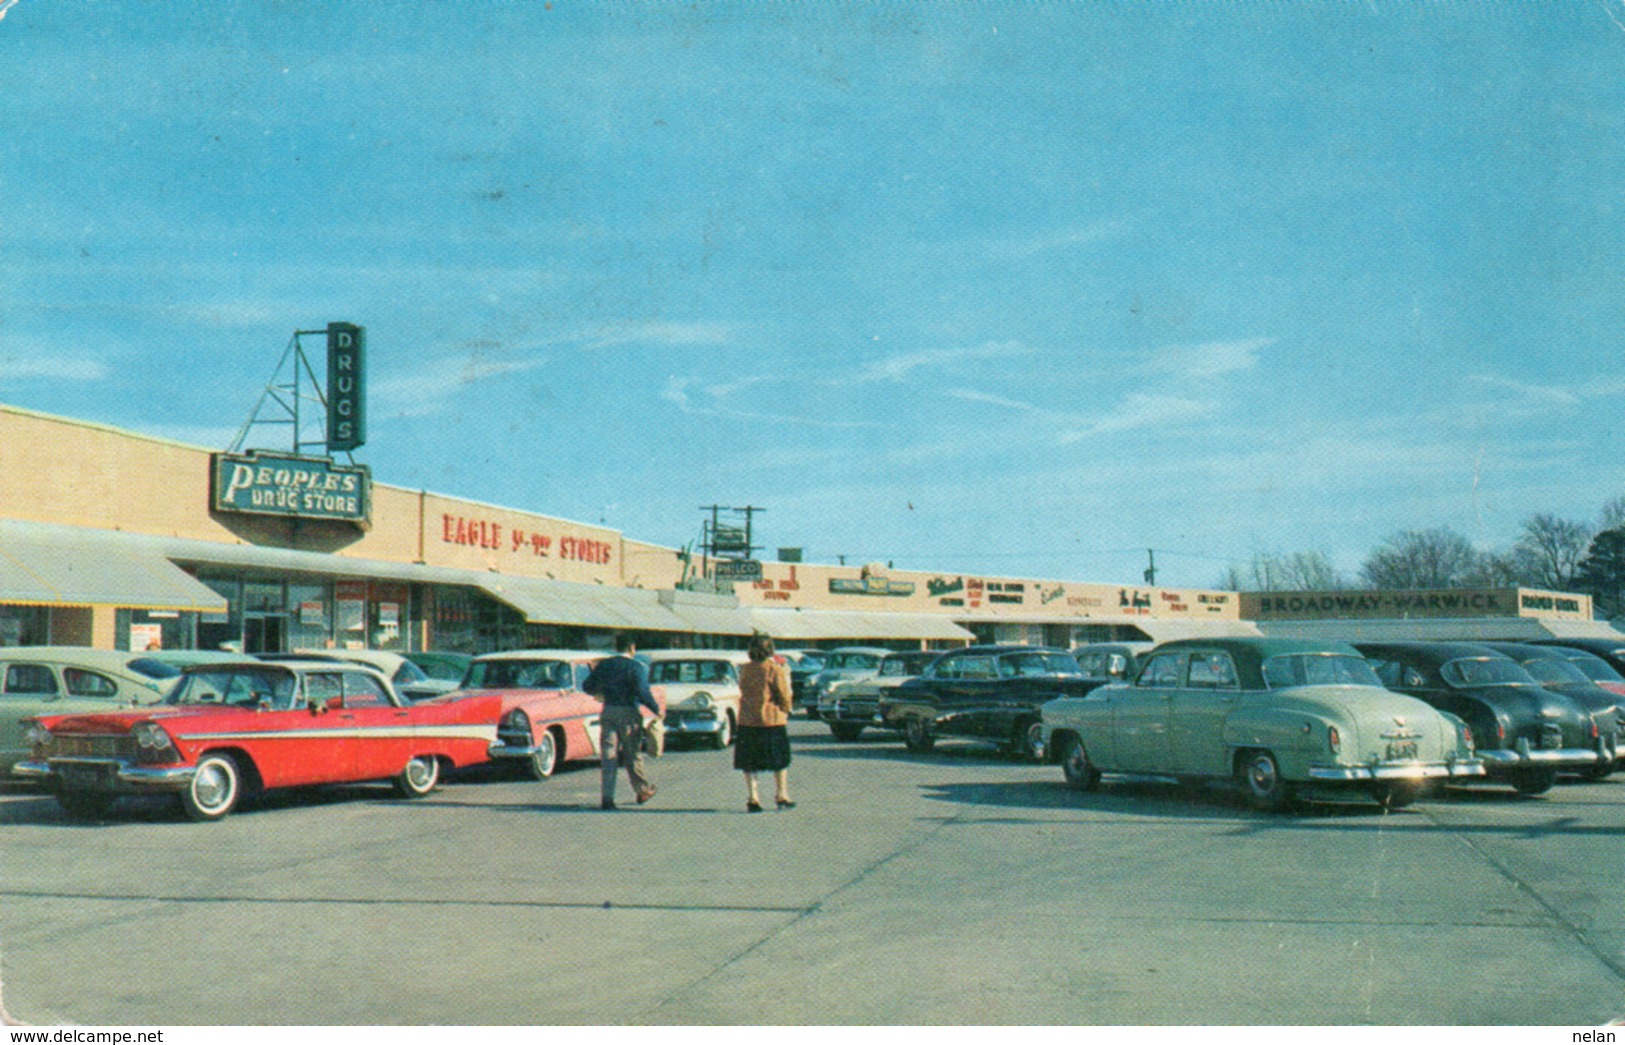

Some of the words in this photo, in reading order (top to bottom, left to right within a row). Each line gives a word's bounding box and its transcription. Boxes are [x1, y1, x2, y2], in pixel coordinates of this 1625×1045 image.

[337, 332, 352, 439] DRUGS
[221, 463, 358, 504] PEOPLES
[251, 488, 298, 509] DRUG
[303, 493, 357, 513] STORE
[442, 513, 502, 550] EAGLE
[560, 535, 612, 564] STORES
[716, 563, 757, 574] PHILCO
[1260, 593, 1501, 612] BROADWAY-WARWICK
